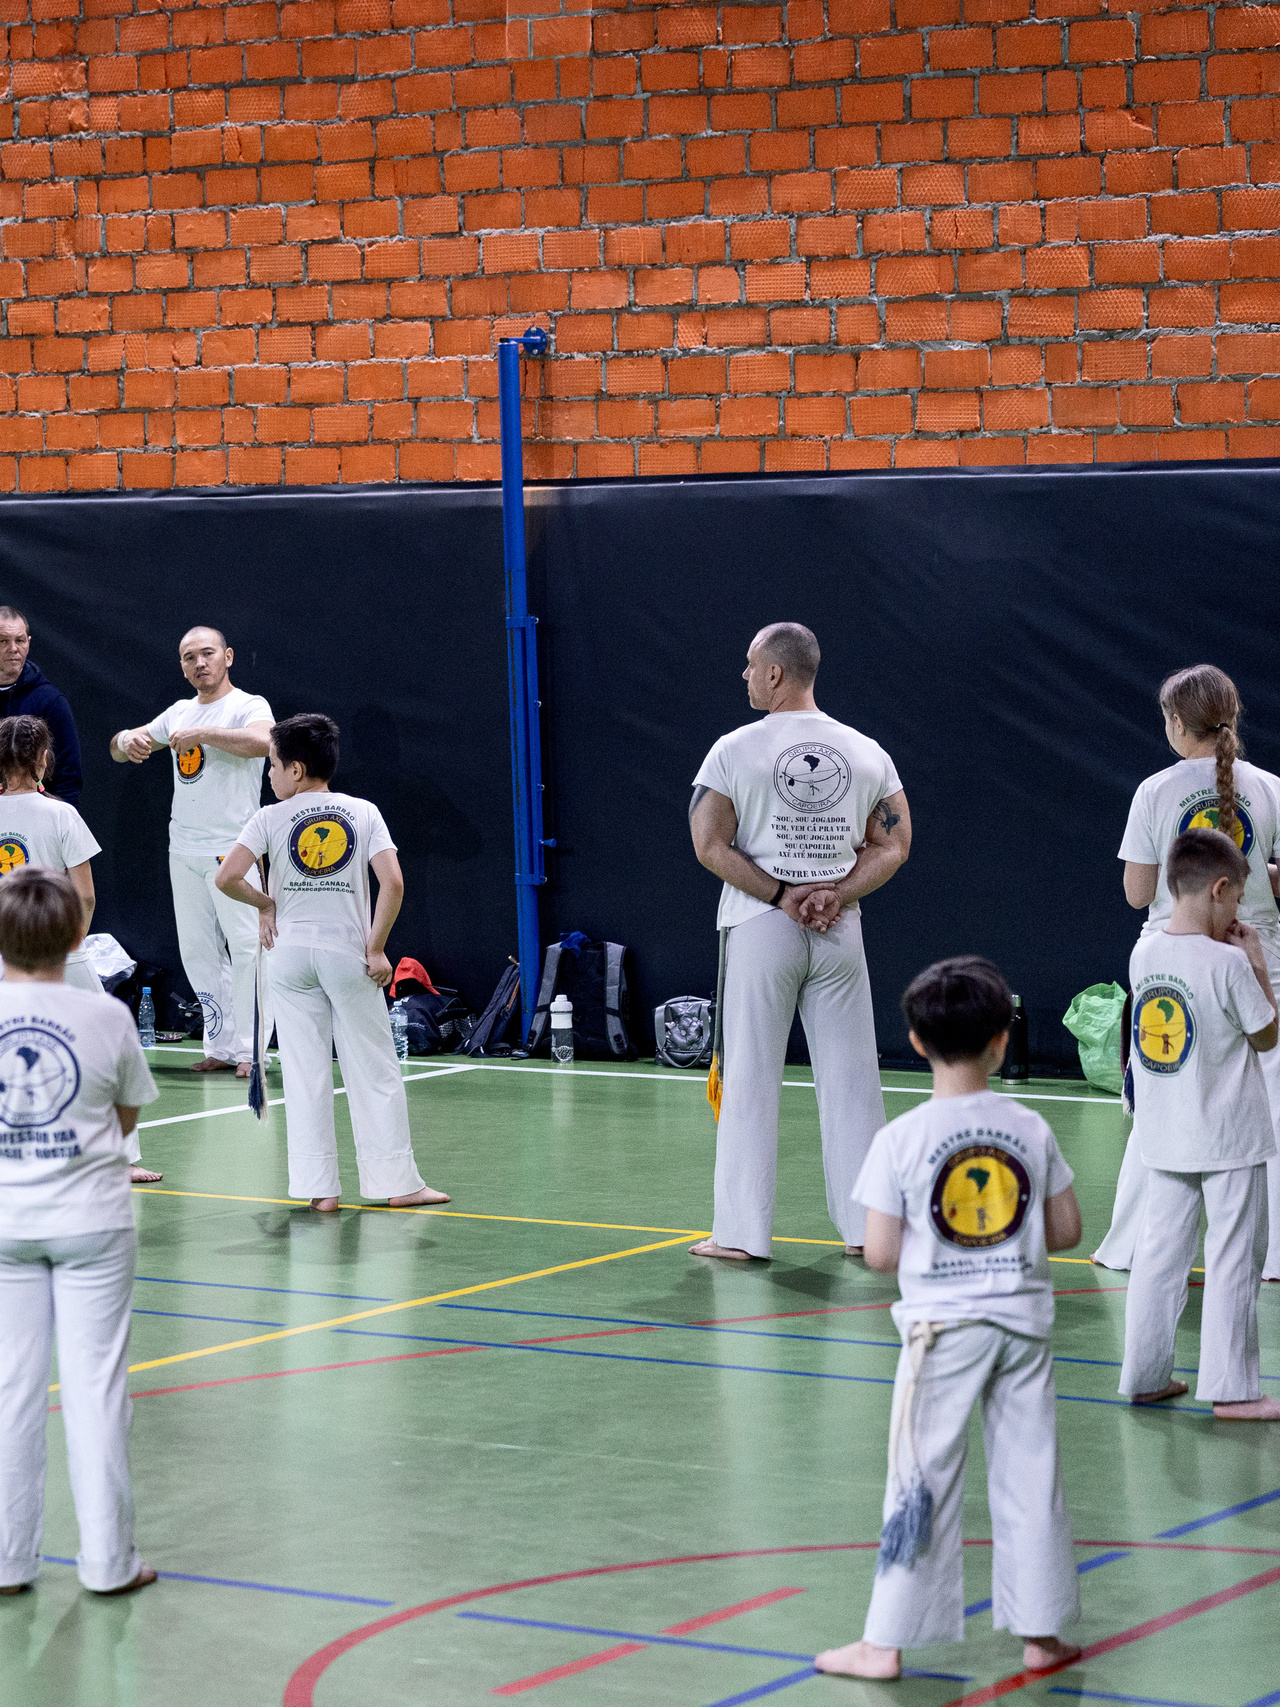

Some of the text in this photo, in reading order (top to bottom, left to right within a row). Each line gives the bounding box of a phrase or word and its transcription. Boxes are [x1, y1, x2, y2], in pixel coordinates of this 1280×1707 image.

[788, 745, 817, 759] GRUPO
[1179, 788, 1214, 808] MESTRE
[791, 799, 832, 809] CAPOEIRA
[1189, 799, 1220, 816] GRUPO
[290, 805, 355, 823] MESTRE BARRÃO
[304, 815, 329, 826] GRUPO
[811, 816, 846, 824] JOGADOR
[771, 823, 789, 832] VEM,
[807, 823, 818, 832] CÁ
[9, 831, 28, 843] BARRÃO
[776, 833, 793, 841] SOU,
[810, 834, 845, 842] JOGADOR
[799, 843, 836, 851] CAPOEIRA
[778, 850, 792, 858] AXÉ
[793, 850, 806, 859] ATÉ
[772, 866, 846, 878] MESTRE BARRÃO
[319, 880, 351, 889] CANADA
[31, 1016, 76, 1042] BARRÃO
[928, 1128, 971, 1165] MESTRE
